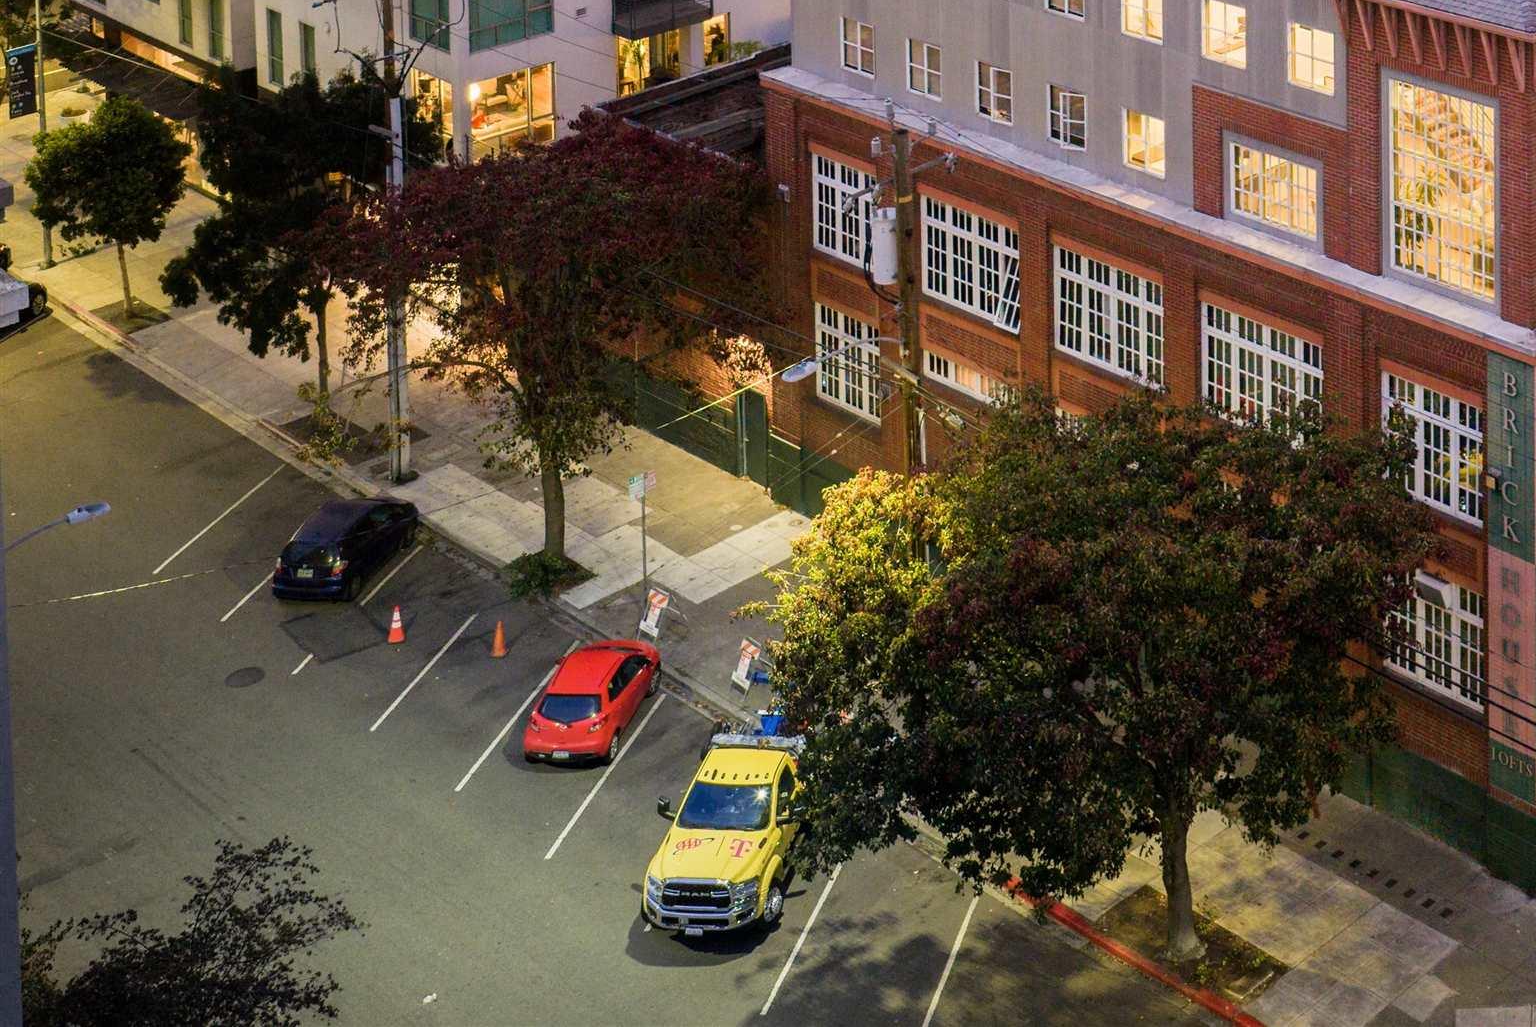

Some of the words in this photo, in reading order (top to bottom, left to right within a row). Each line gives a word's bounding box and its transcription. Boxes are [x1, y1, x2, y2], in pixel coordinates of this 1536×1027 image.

[1501, 371, 1521, 544] BRICK
[1490, 747, 1533, 776] LOFTS
[676, 838, 702, 851] AAA
[731, 838, 753, 859] T
